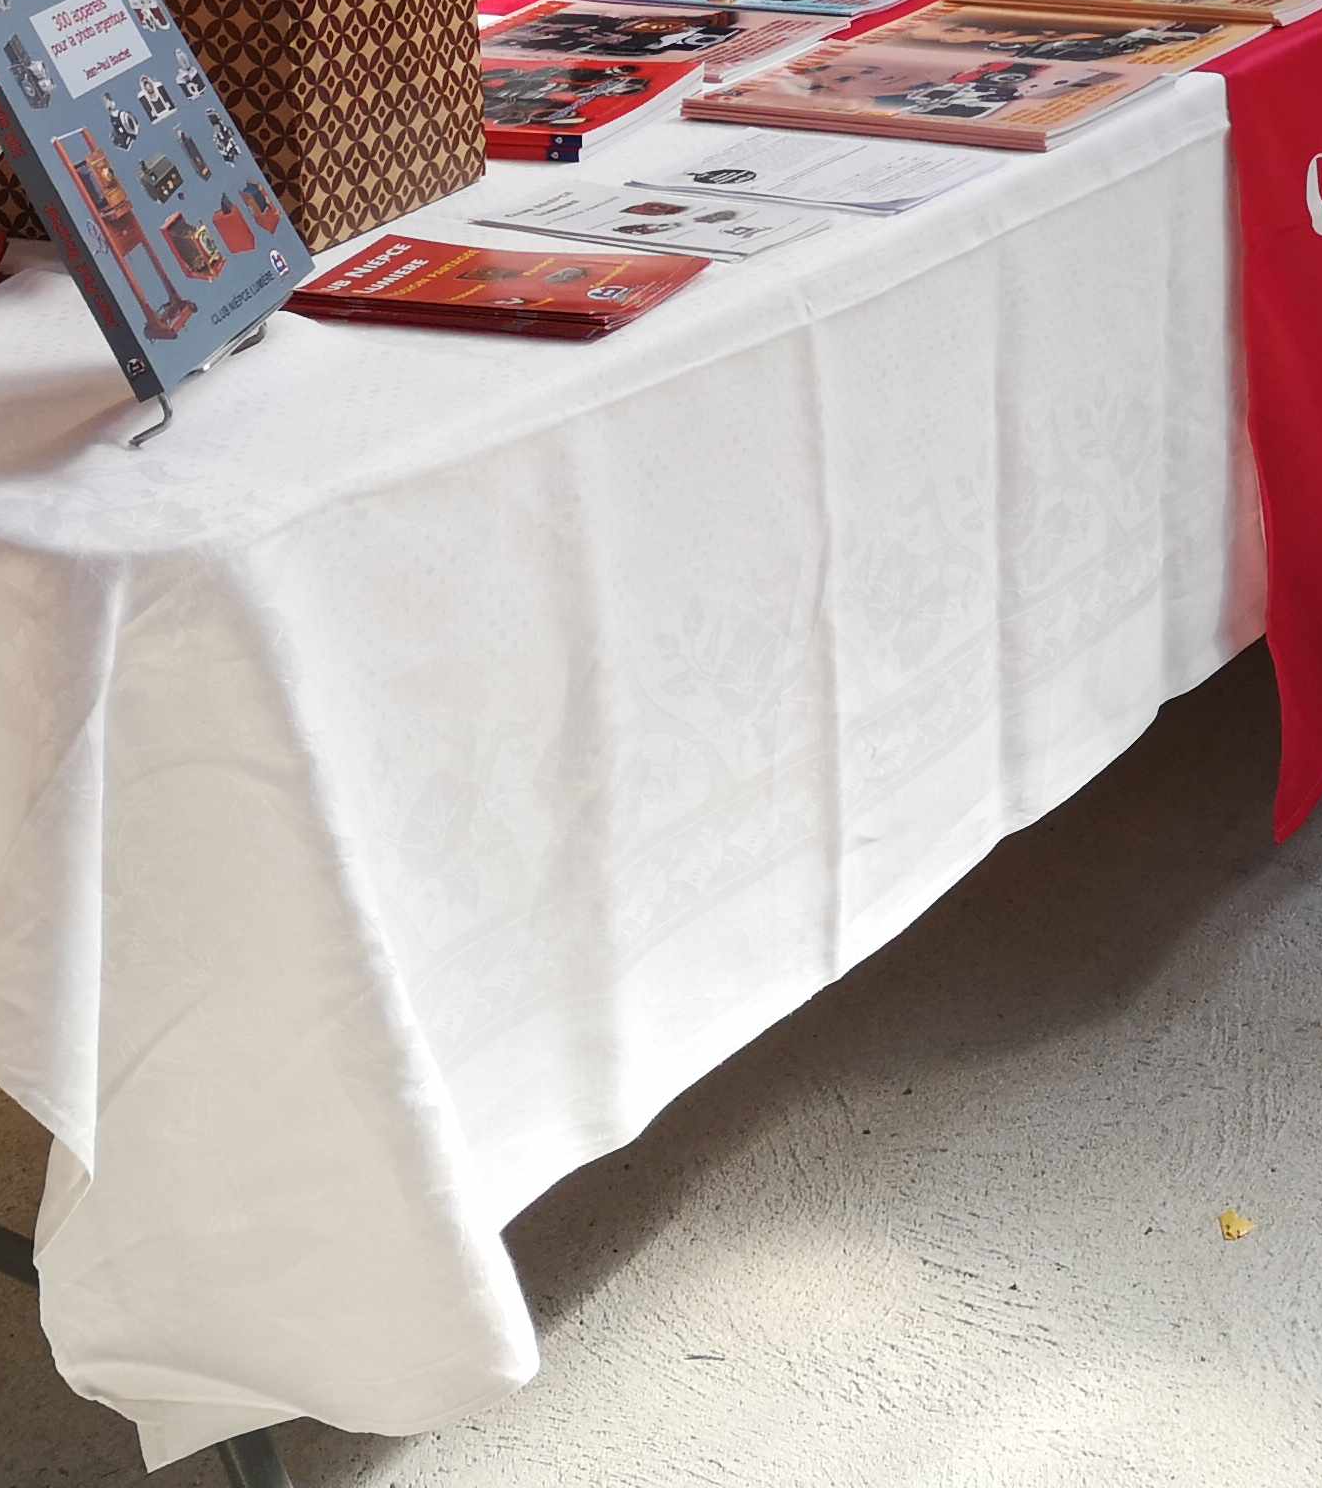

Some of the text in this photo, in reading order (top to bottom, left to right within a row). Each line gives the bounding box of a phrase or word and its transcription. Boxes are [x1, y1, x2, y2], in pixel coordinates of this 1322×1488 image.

[50, 39, 69, 58] pour
[75, 25, 97, 46] photo
[94, 9, 128, 34] argentique
[52, 10, 73, 32] 300
